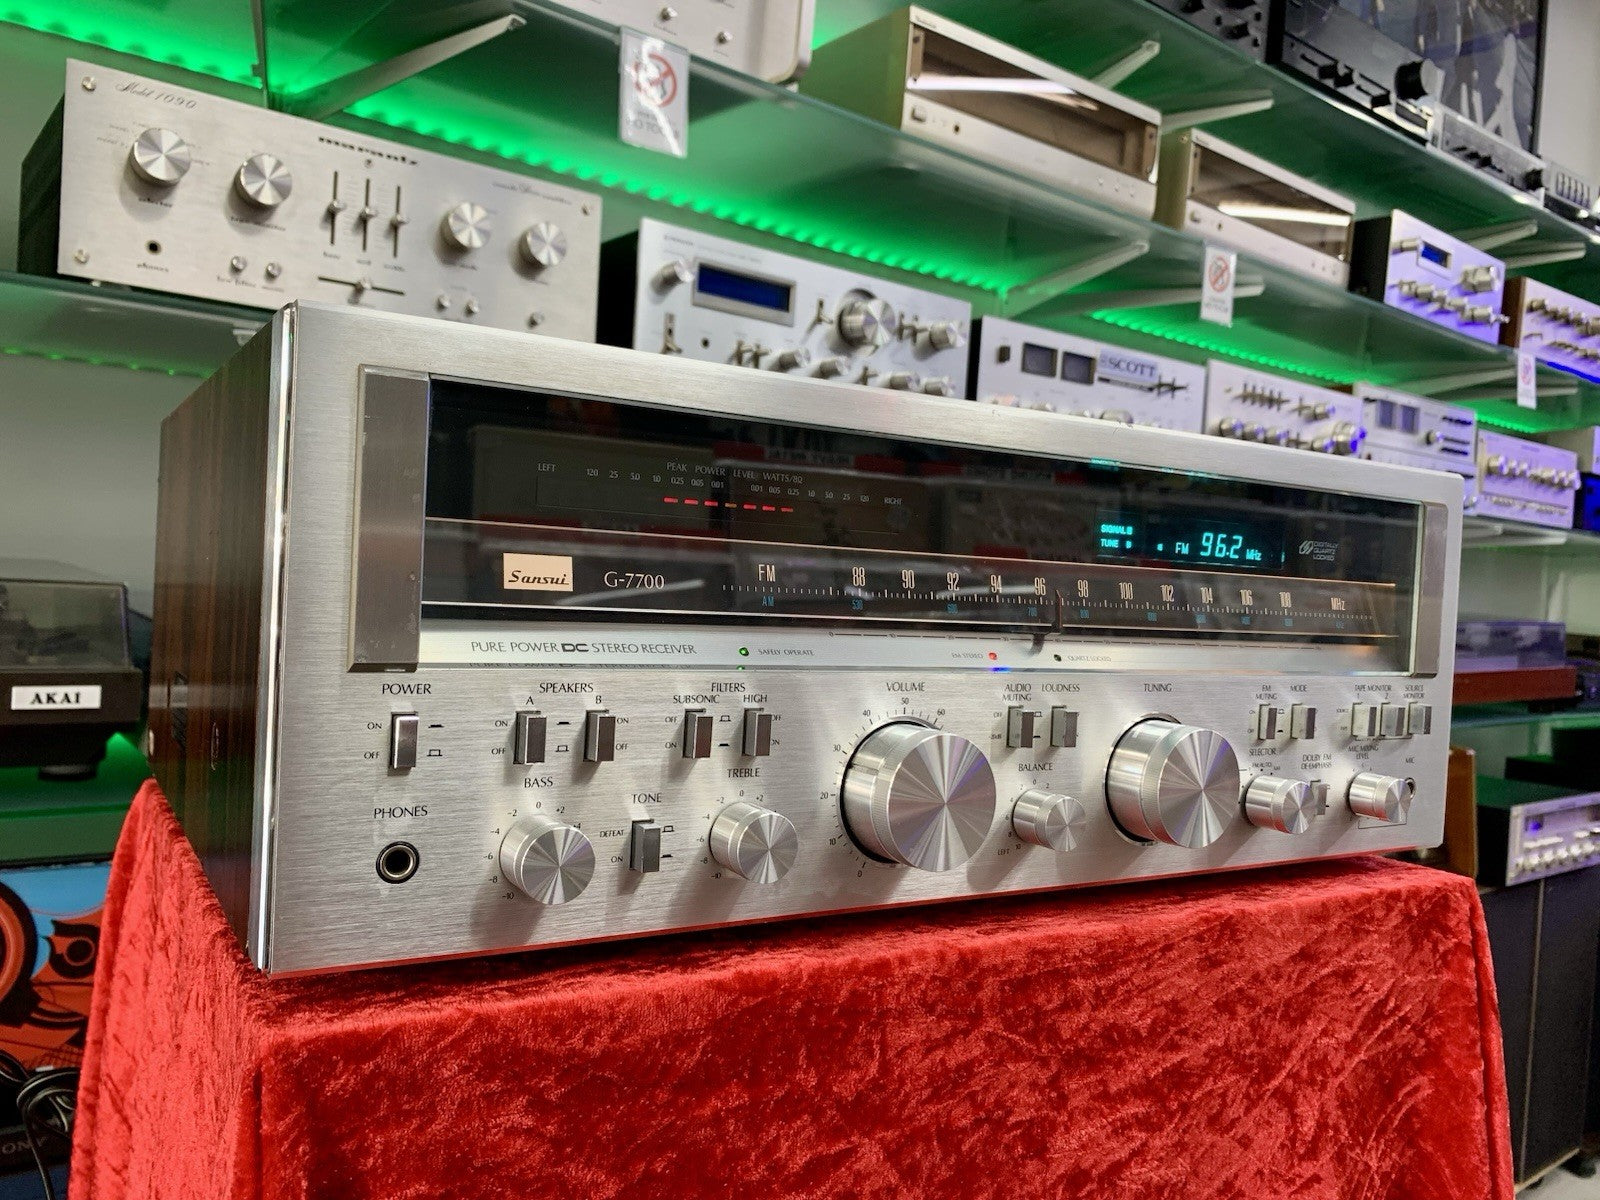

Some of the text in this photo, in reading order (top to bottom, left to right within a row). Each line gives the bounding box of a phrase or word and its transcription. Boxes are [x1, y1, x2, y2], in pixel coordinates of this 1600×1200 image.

[537, 462, 556, 472] LEFT
[666, 461, 688, 473] PEAK
[695, 465, 726, 476] POWER
[733, 469, 755, 479] LEVEL
[609, 471, 619, 479] 25
[1100, 523, 1126, 535] SIGNAL
[1100, 538, 1119, 548] TUNE
[1175, 532, 1262, 561] FM 96.2 MHz
[508, 570, 570, 586] Sansui
[604, 571, 665, 589] G-7700
[758, 564, 1346, 611] FM 88 90 92 94 96 98 100 102 104 106 108 MHz
[761, 595, 775, 607] AM
[471, 641, 698, 655] PURE POWER DC STEREO RECEIVER
[757, 648, 815, 657] SAFELY OPERATE
[382, 683, 432, 695] POWER
[539, 682, 594, 693] SPEAKERS
[711, 682, 746, 692] FILTERS
[886, 682, 926, 692] VOLUME
[1005, 683, 1032, 693] AUDIO
[1041, 683, 1081, 692] LOUDNESS
[1143, 683, 1173, 693] TUNING
[1290, 685, 1308, 693] MODE
[31, 692, 81, 705] AKAI
[525, 696, 535, 706] A
[595, 695, 602, 705] B
[673, 694, 720, 704] SUBSONIC
[743, 694, 768, 703] HIGH
[1002, 693, 1032, 702] MUTING
[862, 709, 871, 717] 40
[937, 708, 946, 716] 60
[367, 722, 383, 730] ON
[494, 720, 509, 728] ON
[616, 718, 629, 726] ON
[615, 743, 629, 751] OFF
[665, 741, 677, 749] ON
[833, 744, 841, 752] 30
[364, 751, 380, 760] OFF
[491, 748, 506, 756] OFF
[1018, 763, 1054, 772] BALANCE
[727, 768, 760, 778] TREBLE
[524, 777, 554, 789] BASS
[632, 793, 662, 805] TONE
[820, 792, 829, 800] 20
[535, 801, 542, 809] 0
[374, 805, 428, 819] PHONES
[600, 829, 625, 837] DEFEAT
[611, 855, 624, 864] ON
